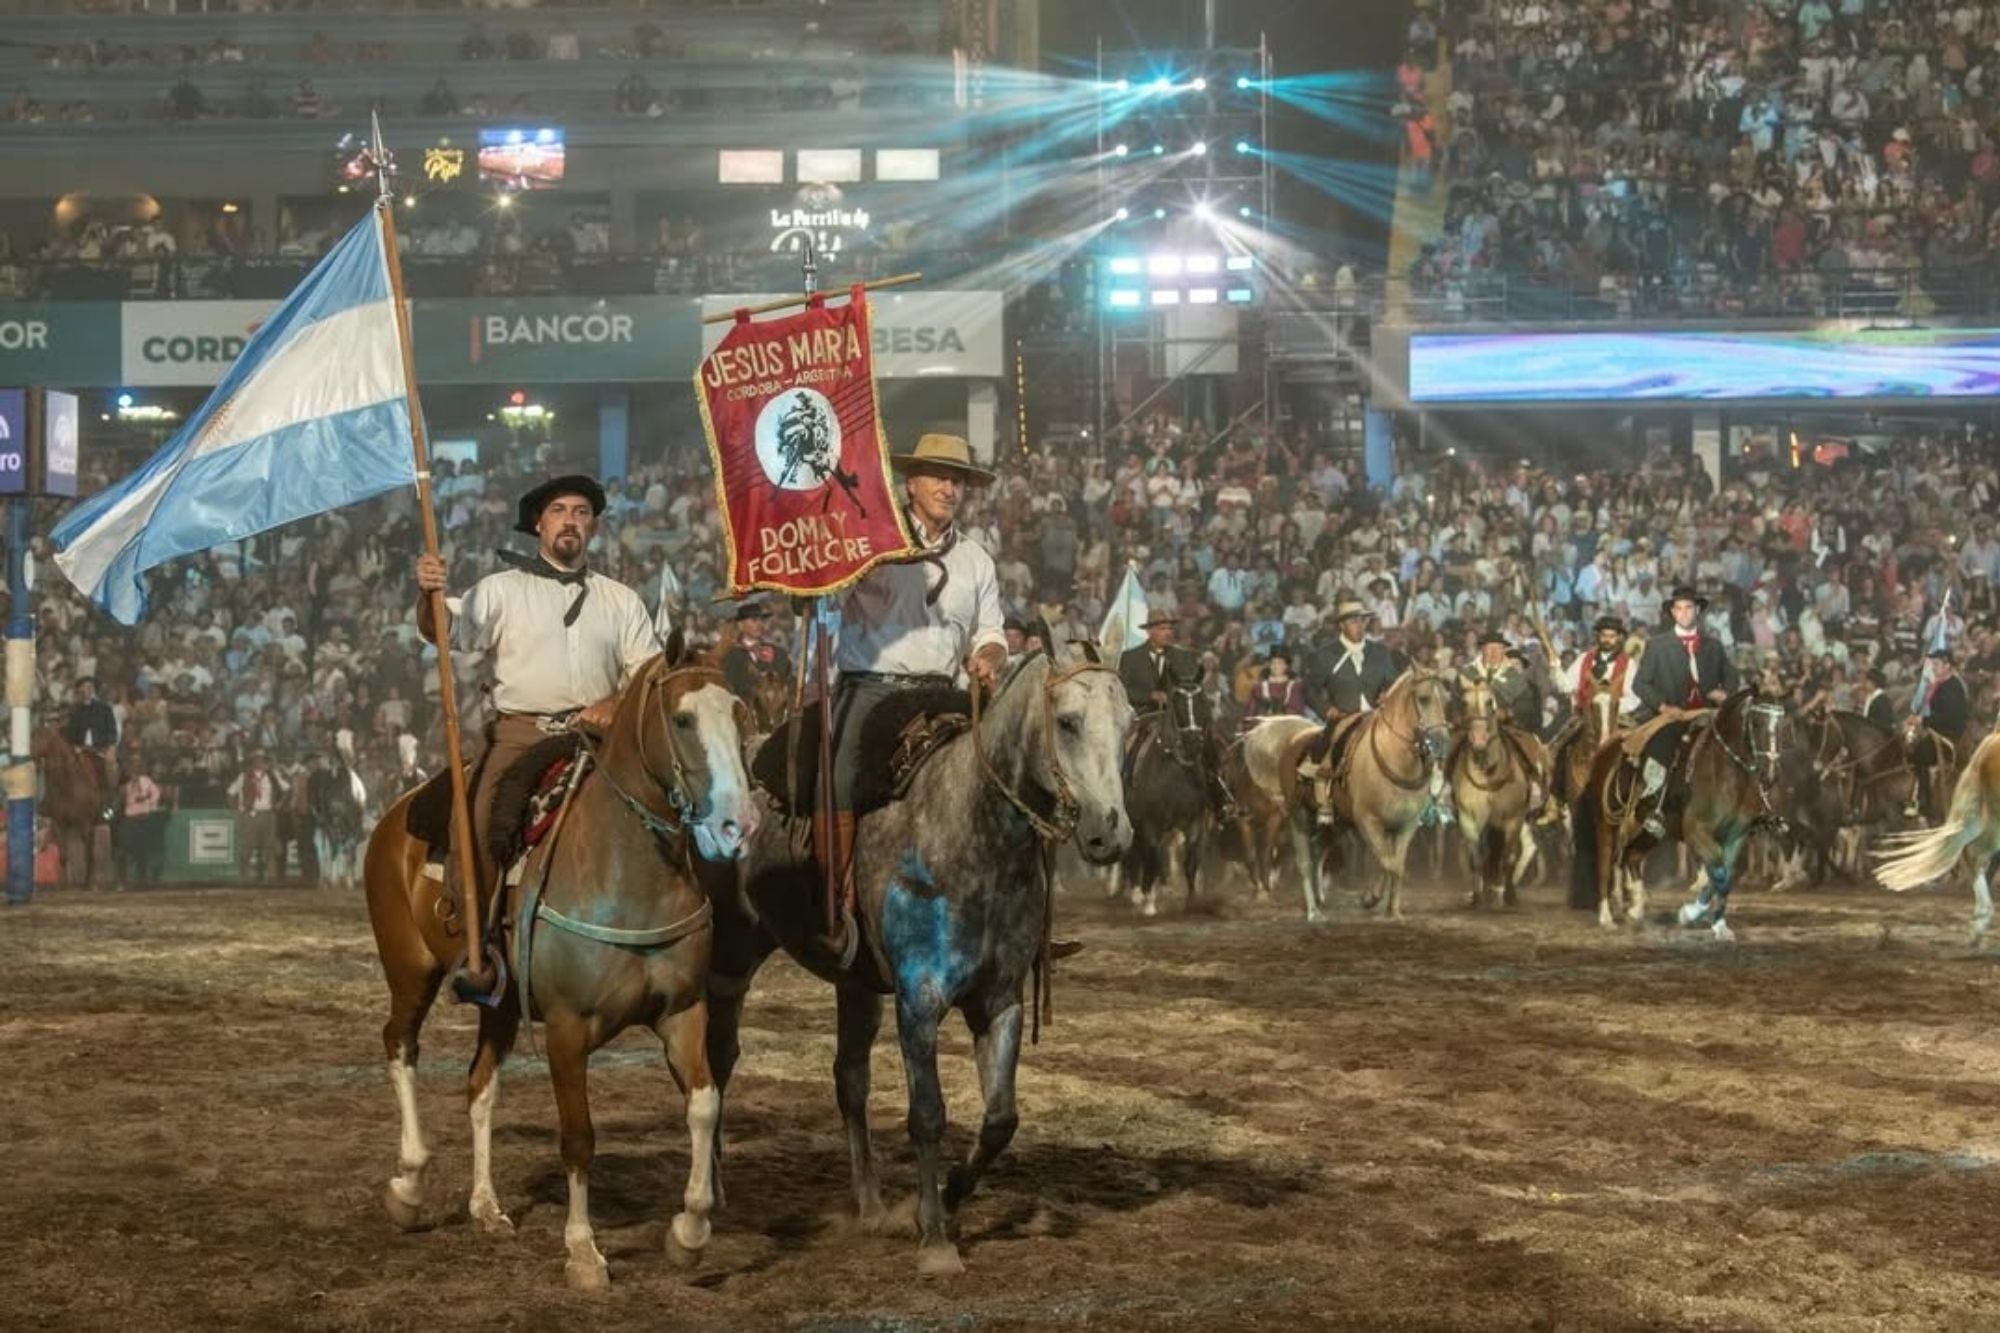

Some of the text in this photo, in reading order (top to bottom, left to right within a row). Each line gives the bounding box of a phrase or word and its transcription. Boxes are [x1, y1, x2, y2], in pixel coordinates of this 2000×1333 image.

[0, 321, 48, 350] OR
[873, 326, 966, 354] BESA
[142, 336, 247, 364] CORD
[707, 340, 784, 388] JESUS
[794, 364, 854, 386] ARGENTA
[0, 452, 21, 472] ro
[760, 515, 833, 552] DOMA
